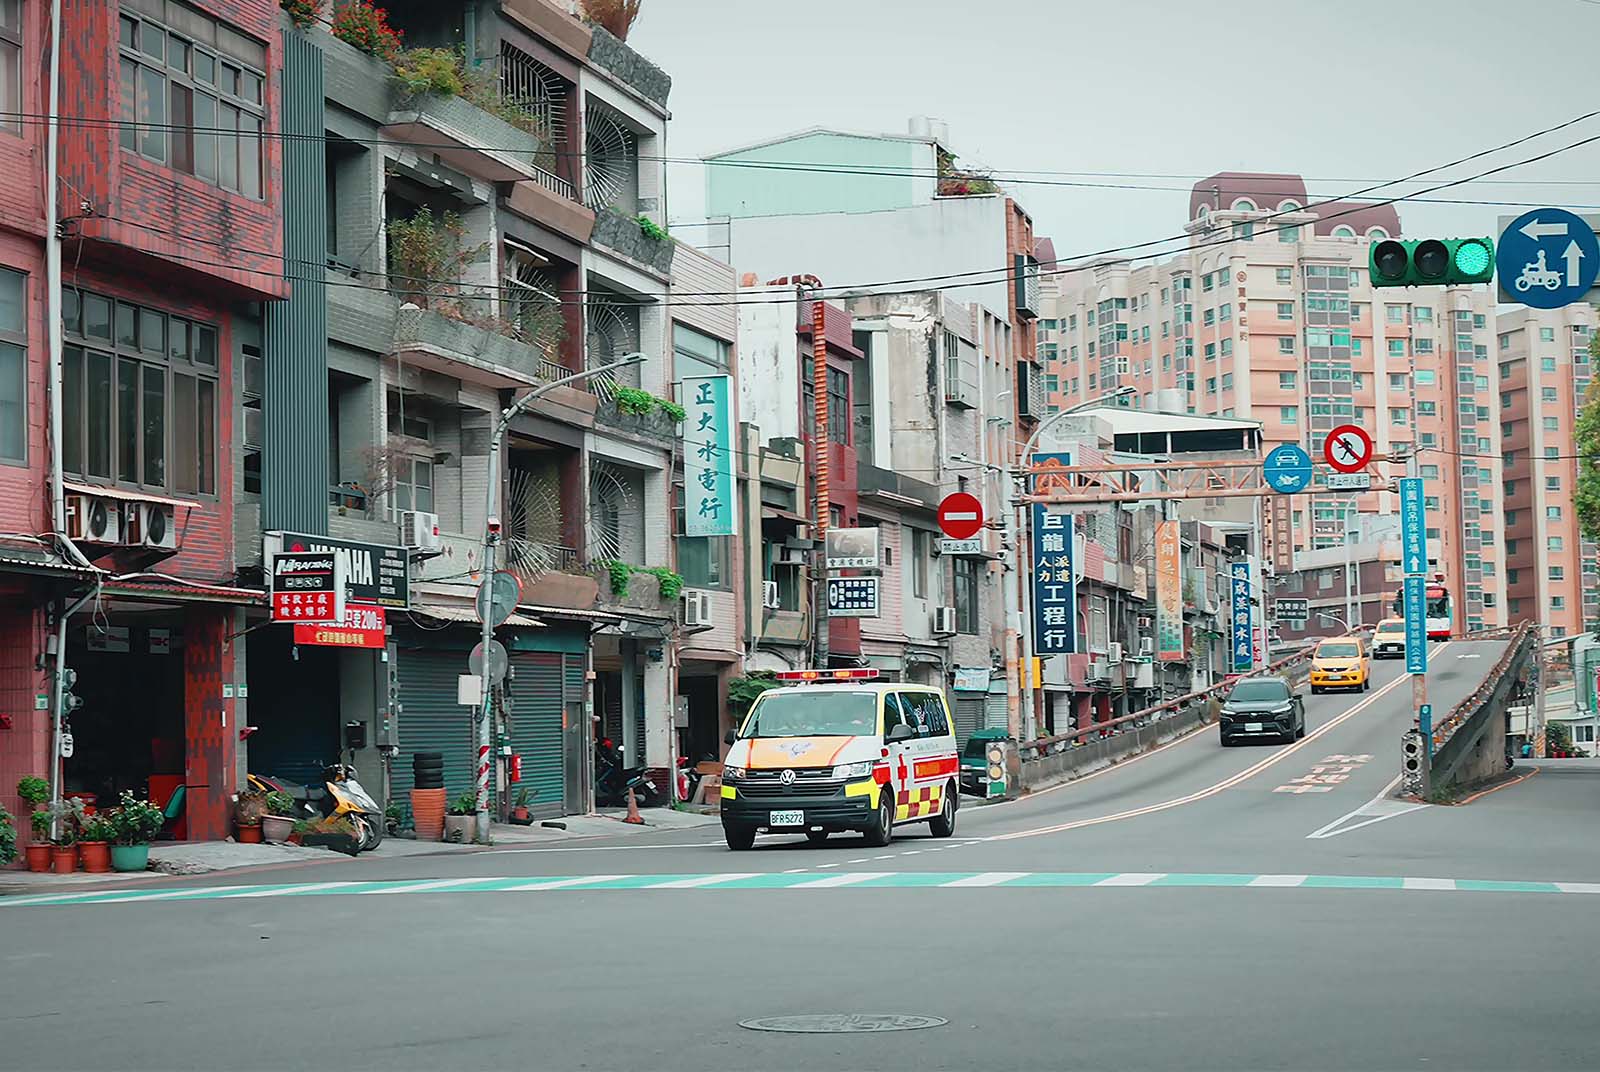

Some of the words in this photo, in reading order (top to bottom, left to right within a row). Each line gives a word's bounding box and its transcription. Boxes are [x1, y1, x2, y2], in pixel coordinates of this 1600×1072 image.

[695, 382, 723, 520] 正大水電行
[943, 542, 979, 552] 禁止進入
